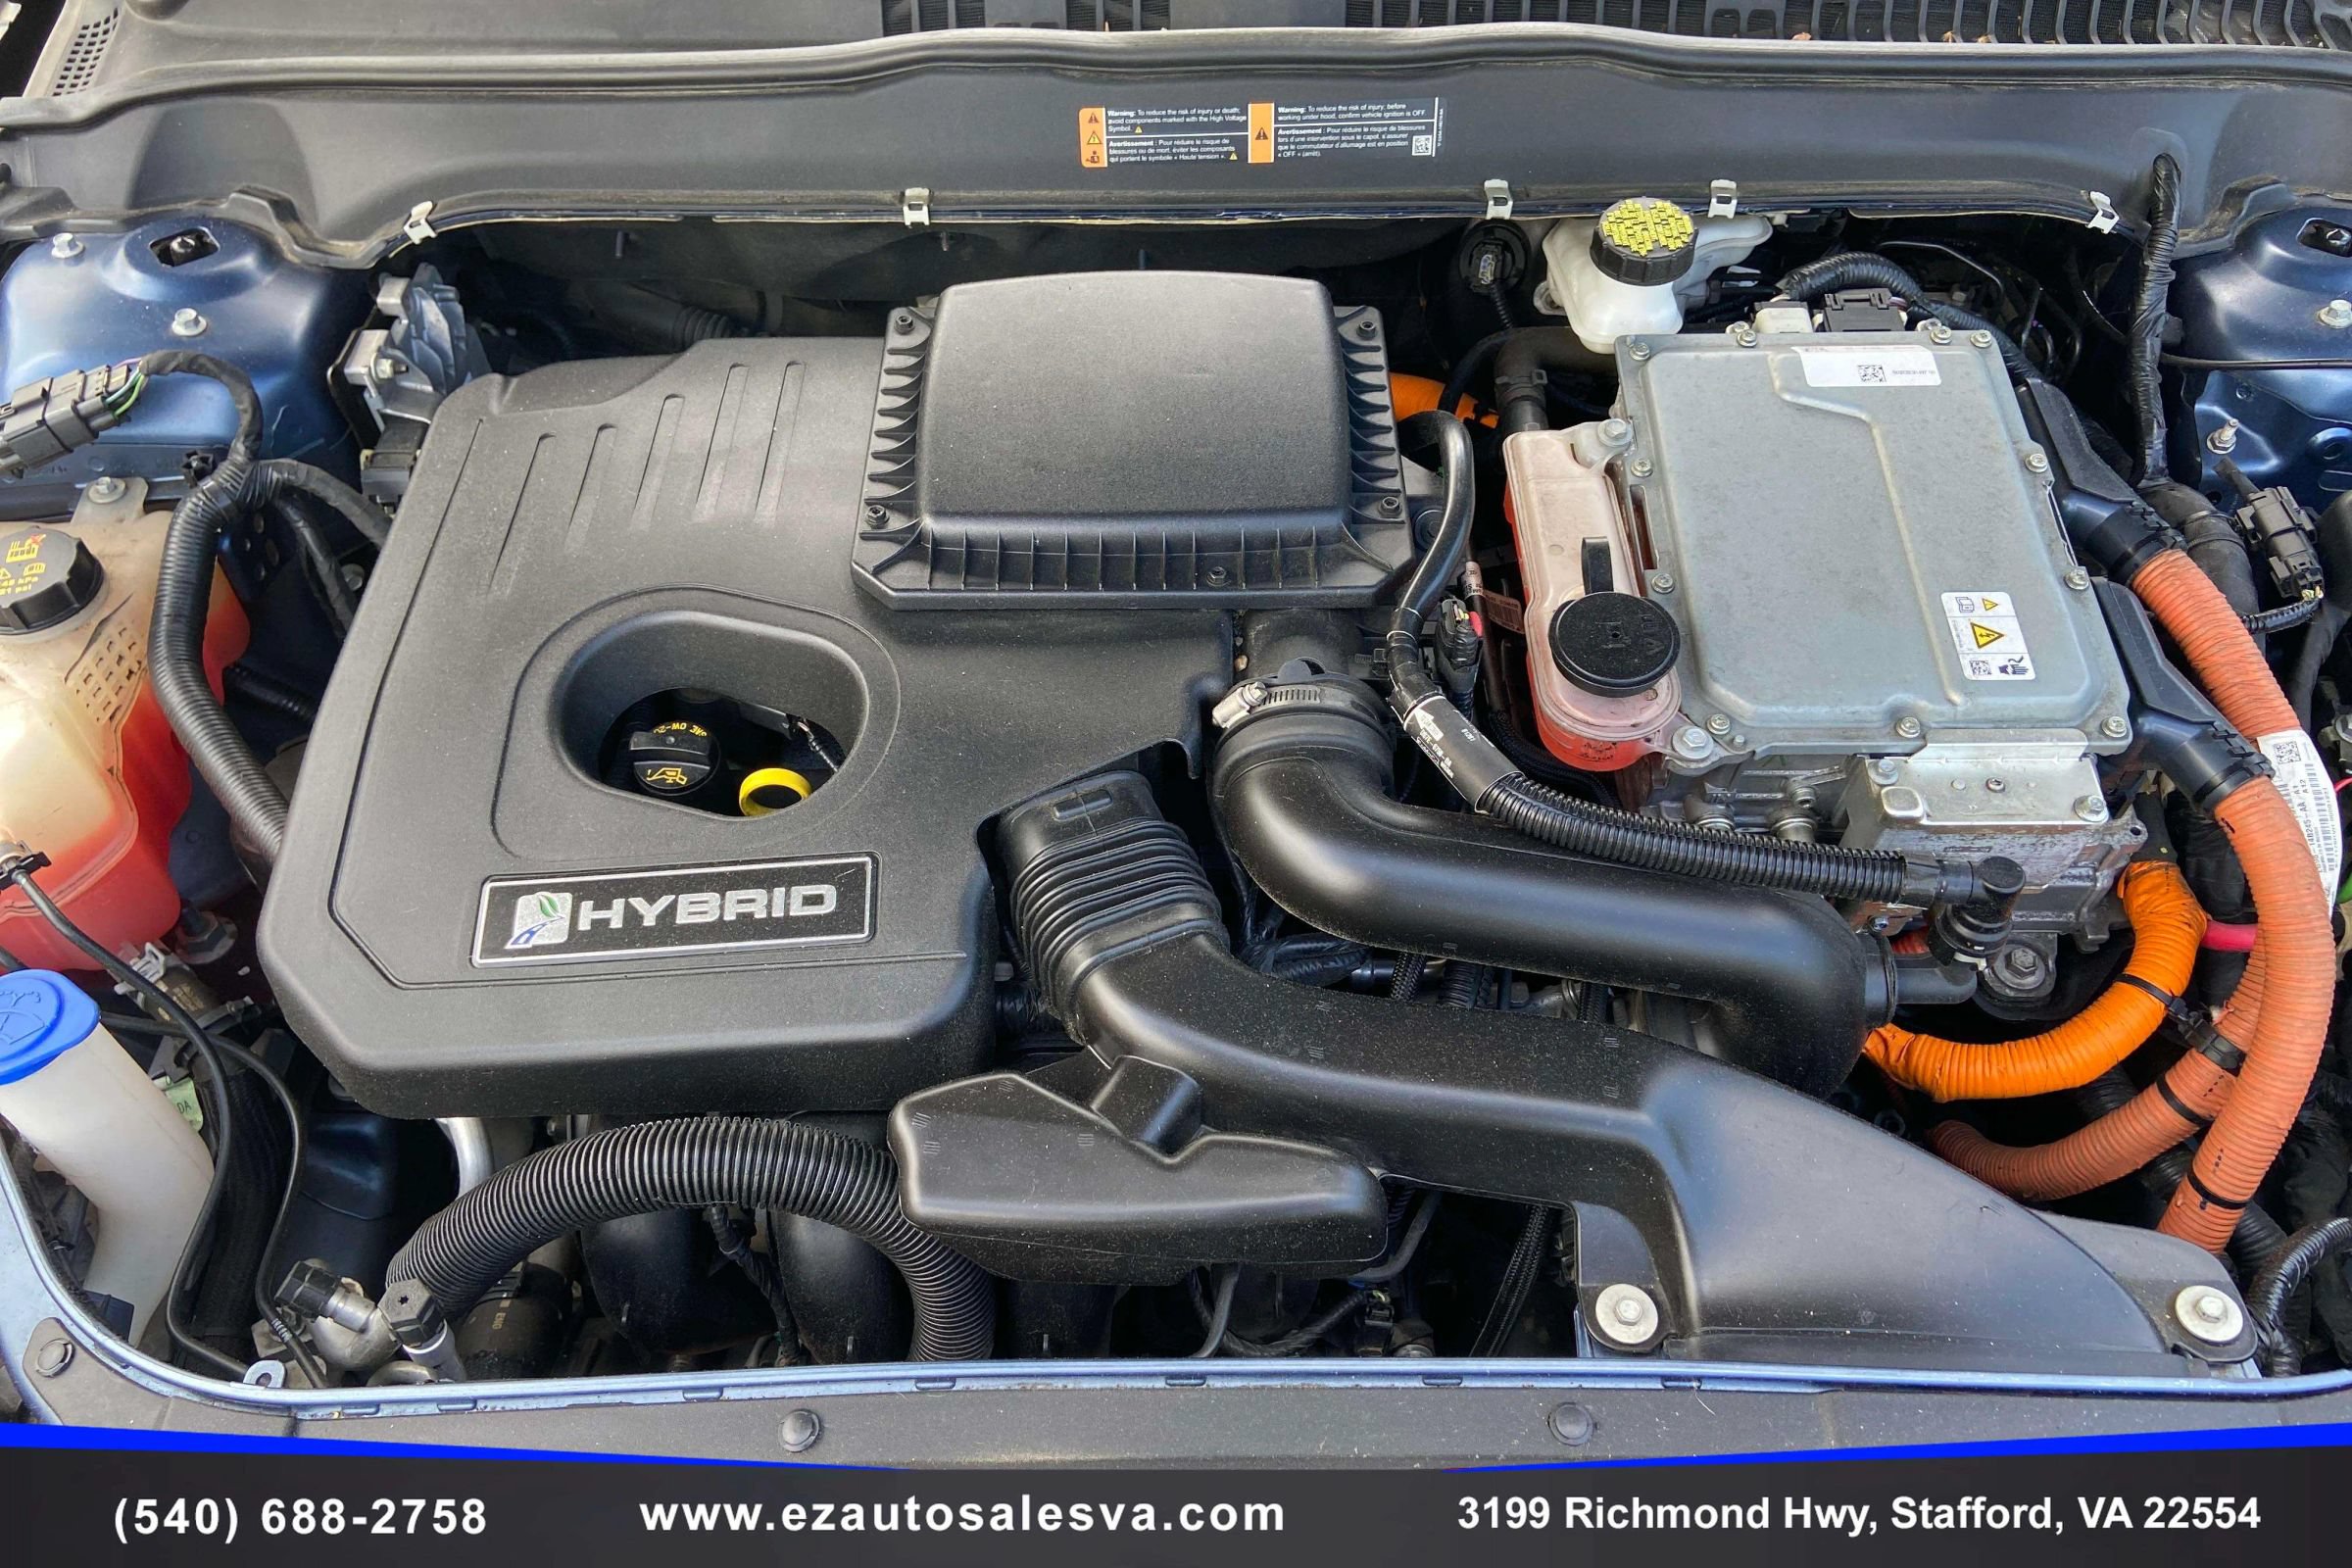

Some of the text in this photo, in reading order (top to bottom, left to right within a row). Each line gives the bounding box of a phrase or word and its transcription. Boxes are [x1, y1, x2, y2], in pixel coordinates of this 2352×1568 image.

[1277, 106, 1307, 115] Warning:
[1209, 115, 1224, 123] High
[577, 883, 838, 931] HYBRID
